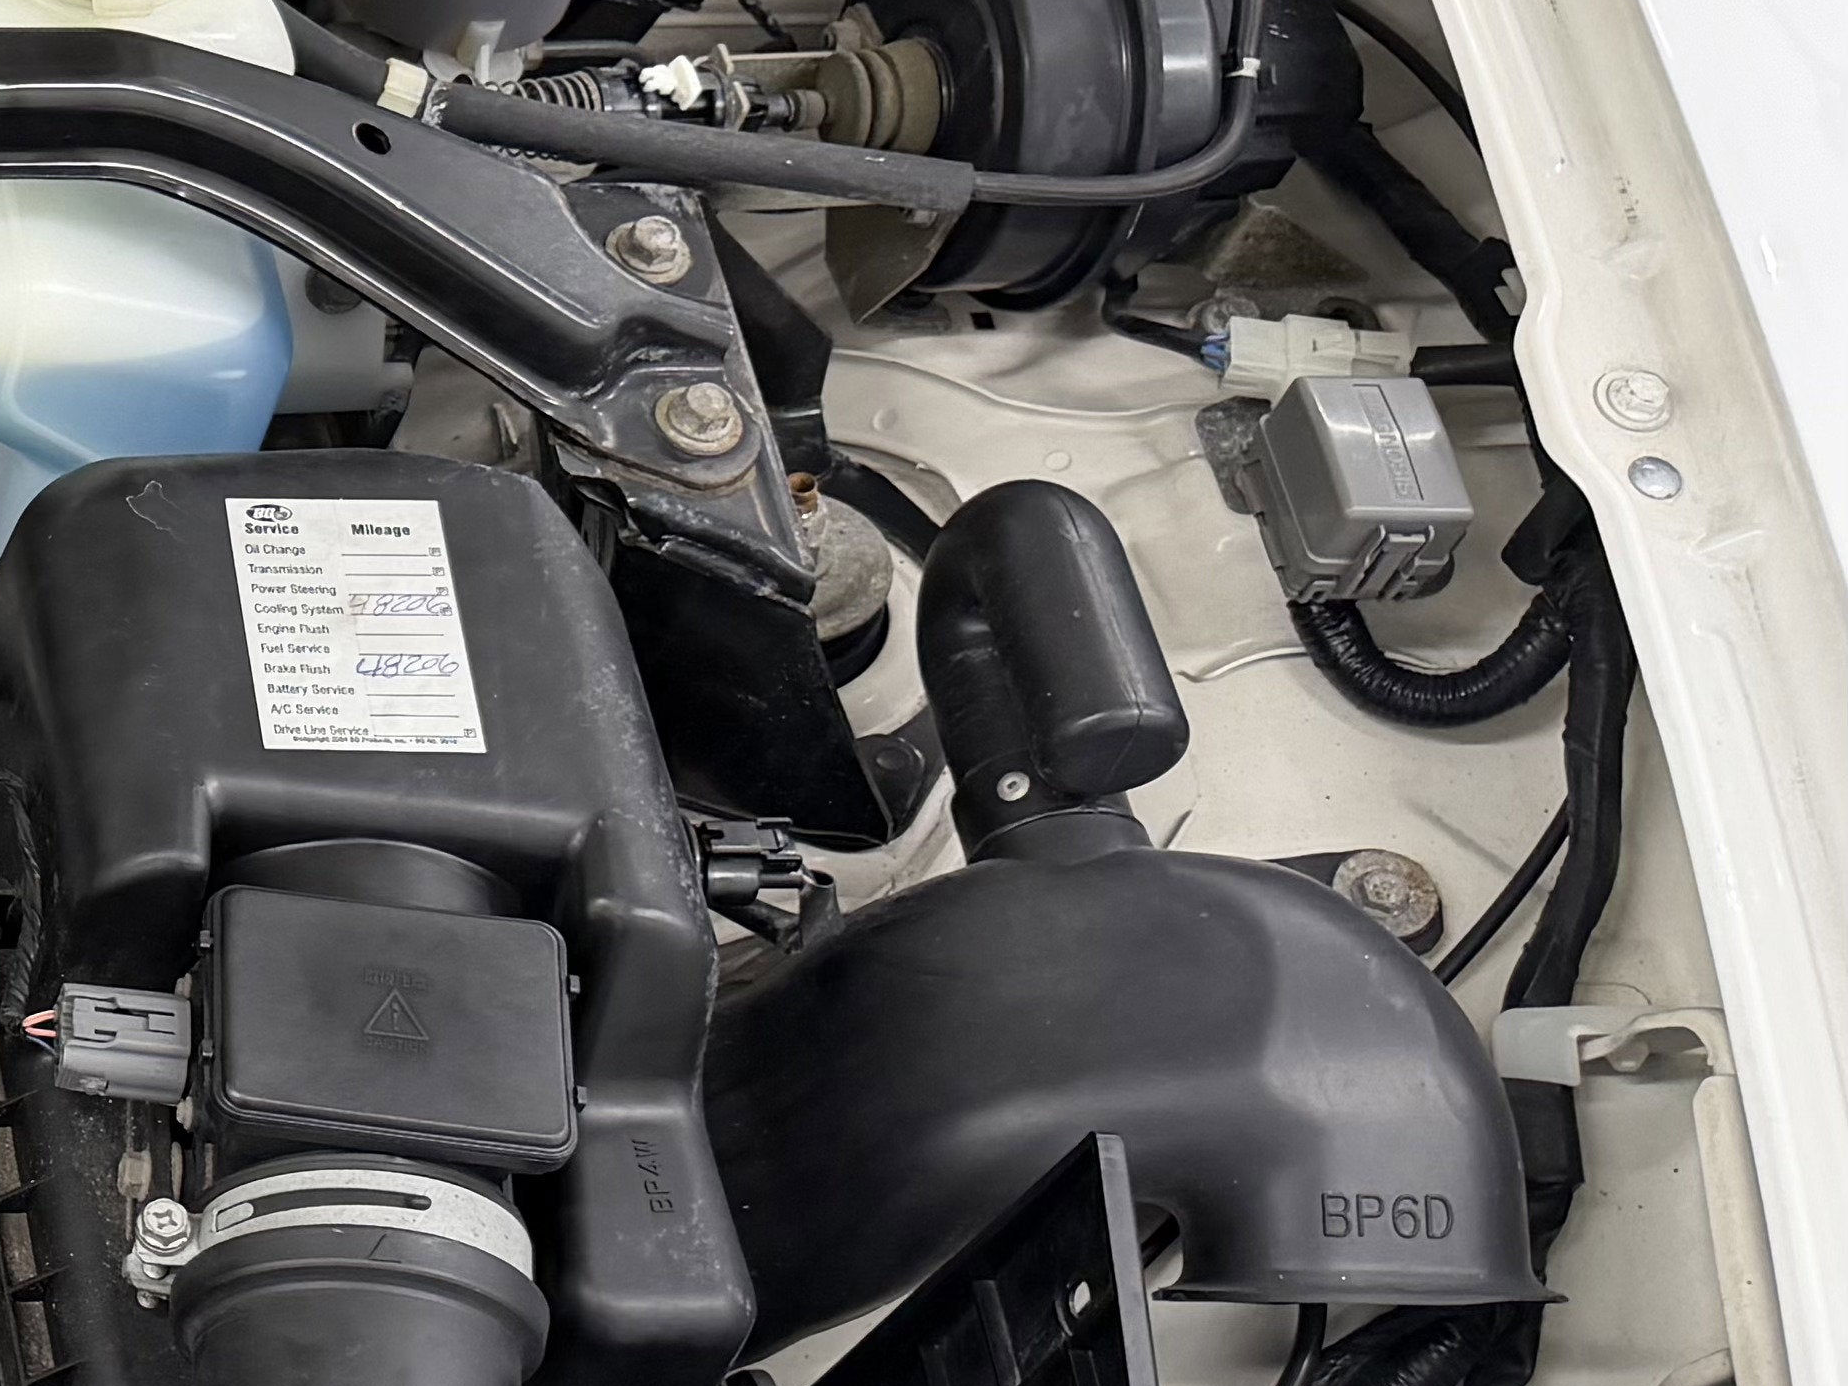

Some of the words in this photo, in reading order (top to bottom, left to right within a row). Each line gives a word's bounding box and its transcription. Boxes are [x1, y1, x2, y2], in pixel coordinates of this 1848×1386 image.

[245, 523, 299, 535] Service
[351, 524, 411, 538] Mileage
[245, 544, 260, 555] Oil
[263, 544, 306, 557] Change
[248, 564, 323, 575] Transmission
[251, 584, 286, 594] Power
[290, 584, 337, 596] Steering
[254, 604, 298, 617] Cooling
[301, 604, 344, 616] System
[258, 624, 296, 636] Engine
[299, 624, 329, 634] Flush
[261, 643, 284, 654] Fuel
[287, 643, 330, 654] Service
[264, 663, 296, 674] Brake
[300, 664, 331, 674] Flush
[356, 654, 459, 679] 48206
[267, 684, 308, 696] Battery
[312, 684, 355, 695] Service
[271, 704, 292, 714] A/C
[296, 704, 338, 715] Service
[274, 724, 301, 734] Drive
[304, 724, 326, 735] Line
[329, 725, 369, 735] Service
[1320, 1192, 1455, 1240] BP6D
